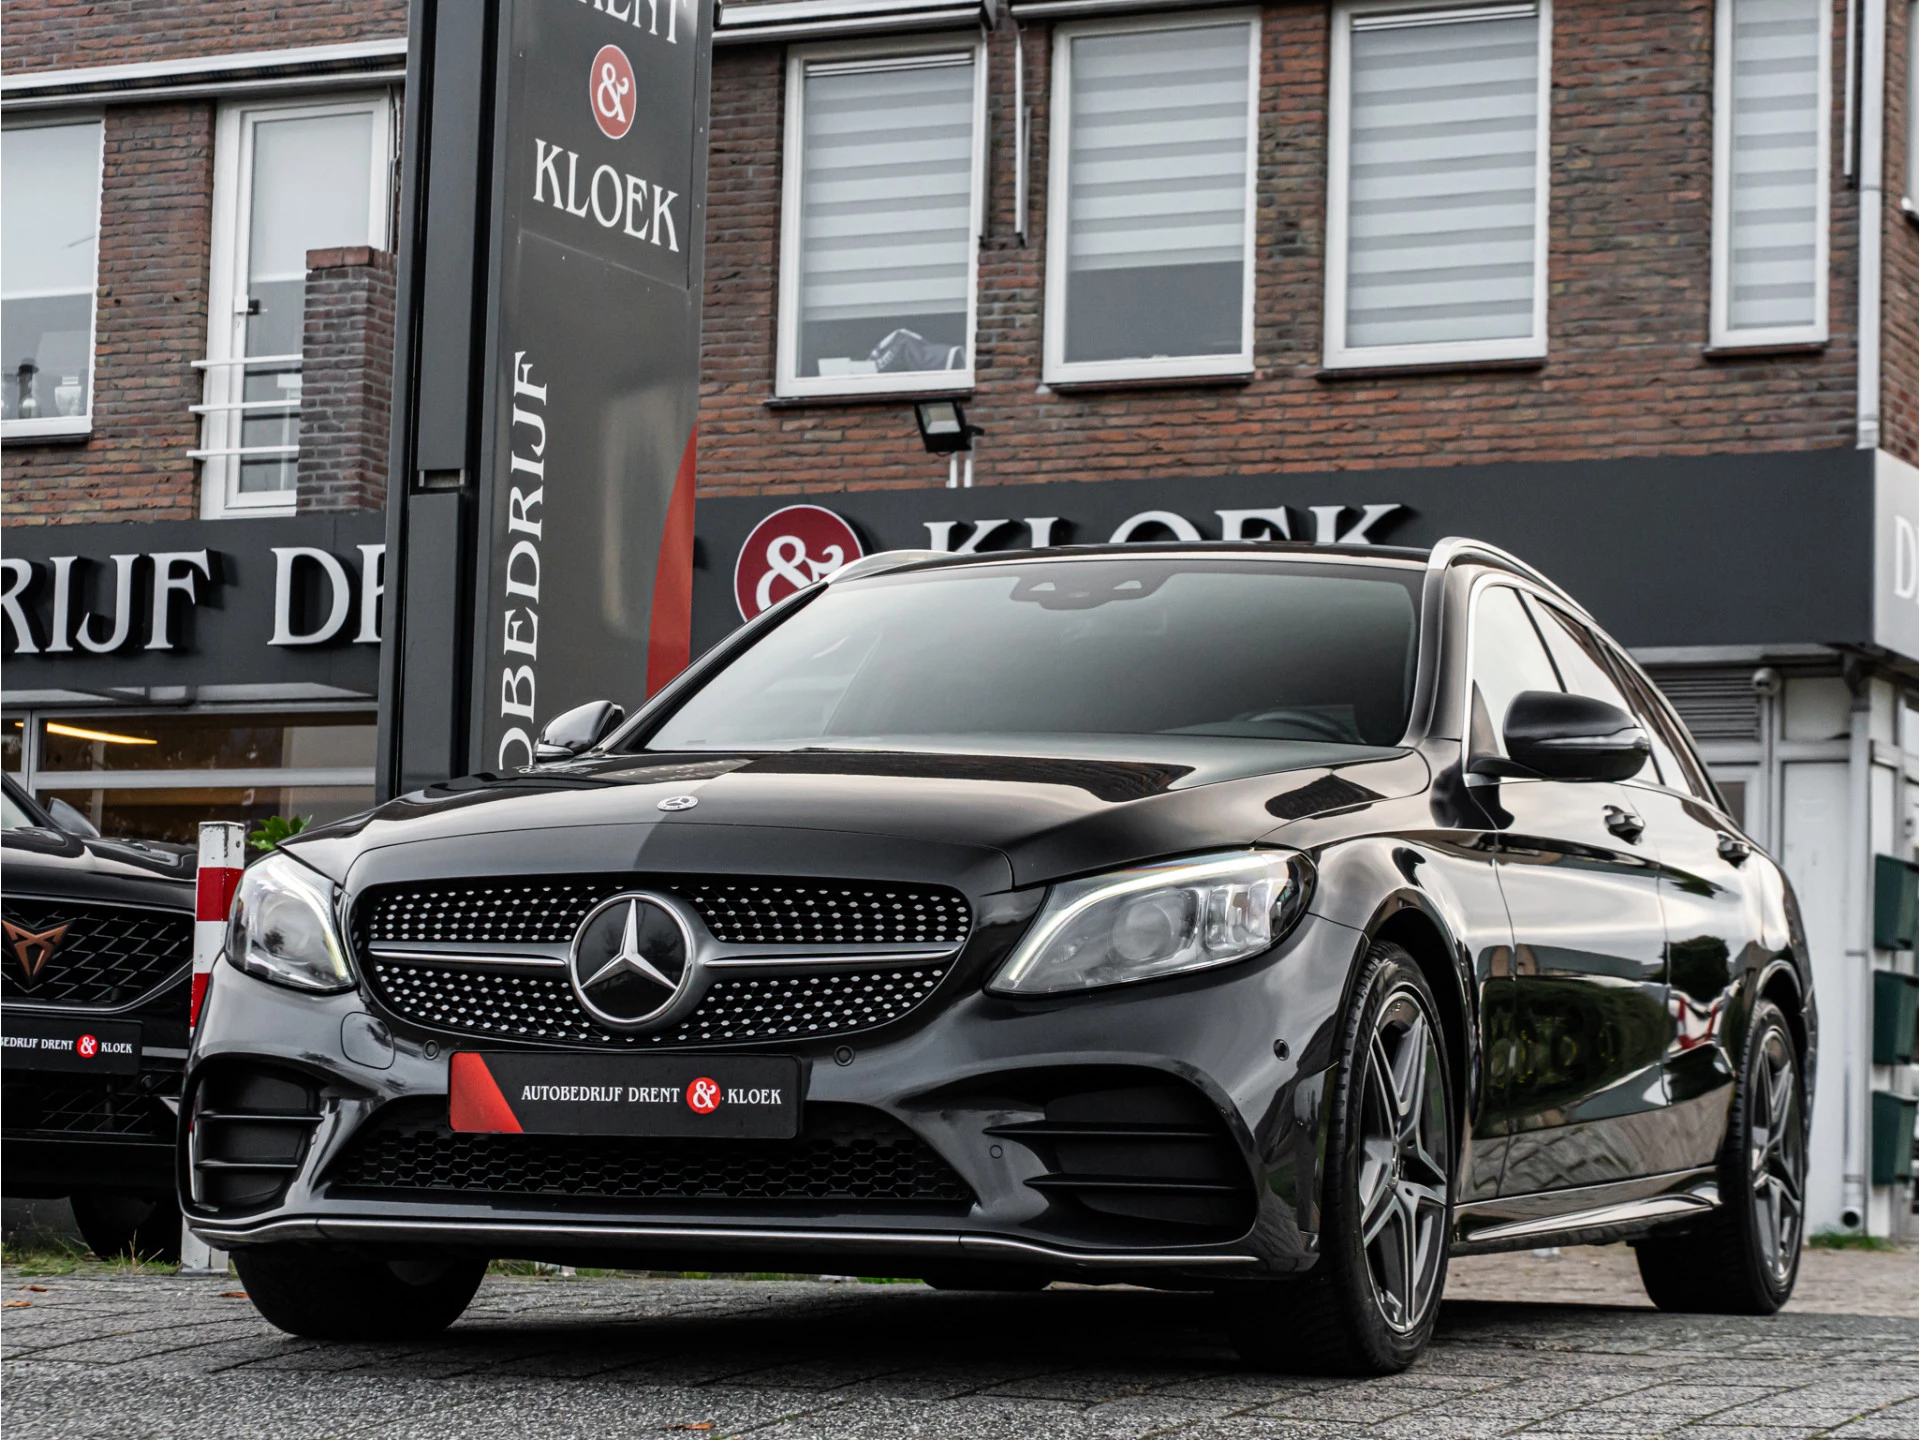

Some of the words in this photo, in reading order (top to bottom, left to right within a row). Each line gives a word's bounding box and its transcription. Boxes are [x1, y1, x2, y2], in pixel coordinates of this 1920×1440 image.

[597, 62, 629, 123] &
[533, 138, 679, 252] KLOEK
[756, 534, 844, 616] &
[41, 1039, 73, 1051] DRENT
[80, 1036, 95, 1054] &
[101, 1042, 132, 1054] KLOEK
[521, 1085, 623, 1102] AUTOBEDRIJF
[628, 1087, 680, 1103] DRENT
[692, 1081, 717, 1108] &
[728, 1089, 781, 1105] KLOEK
